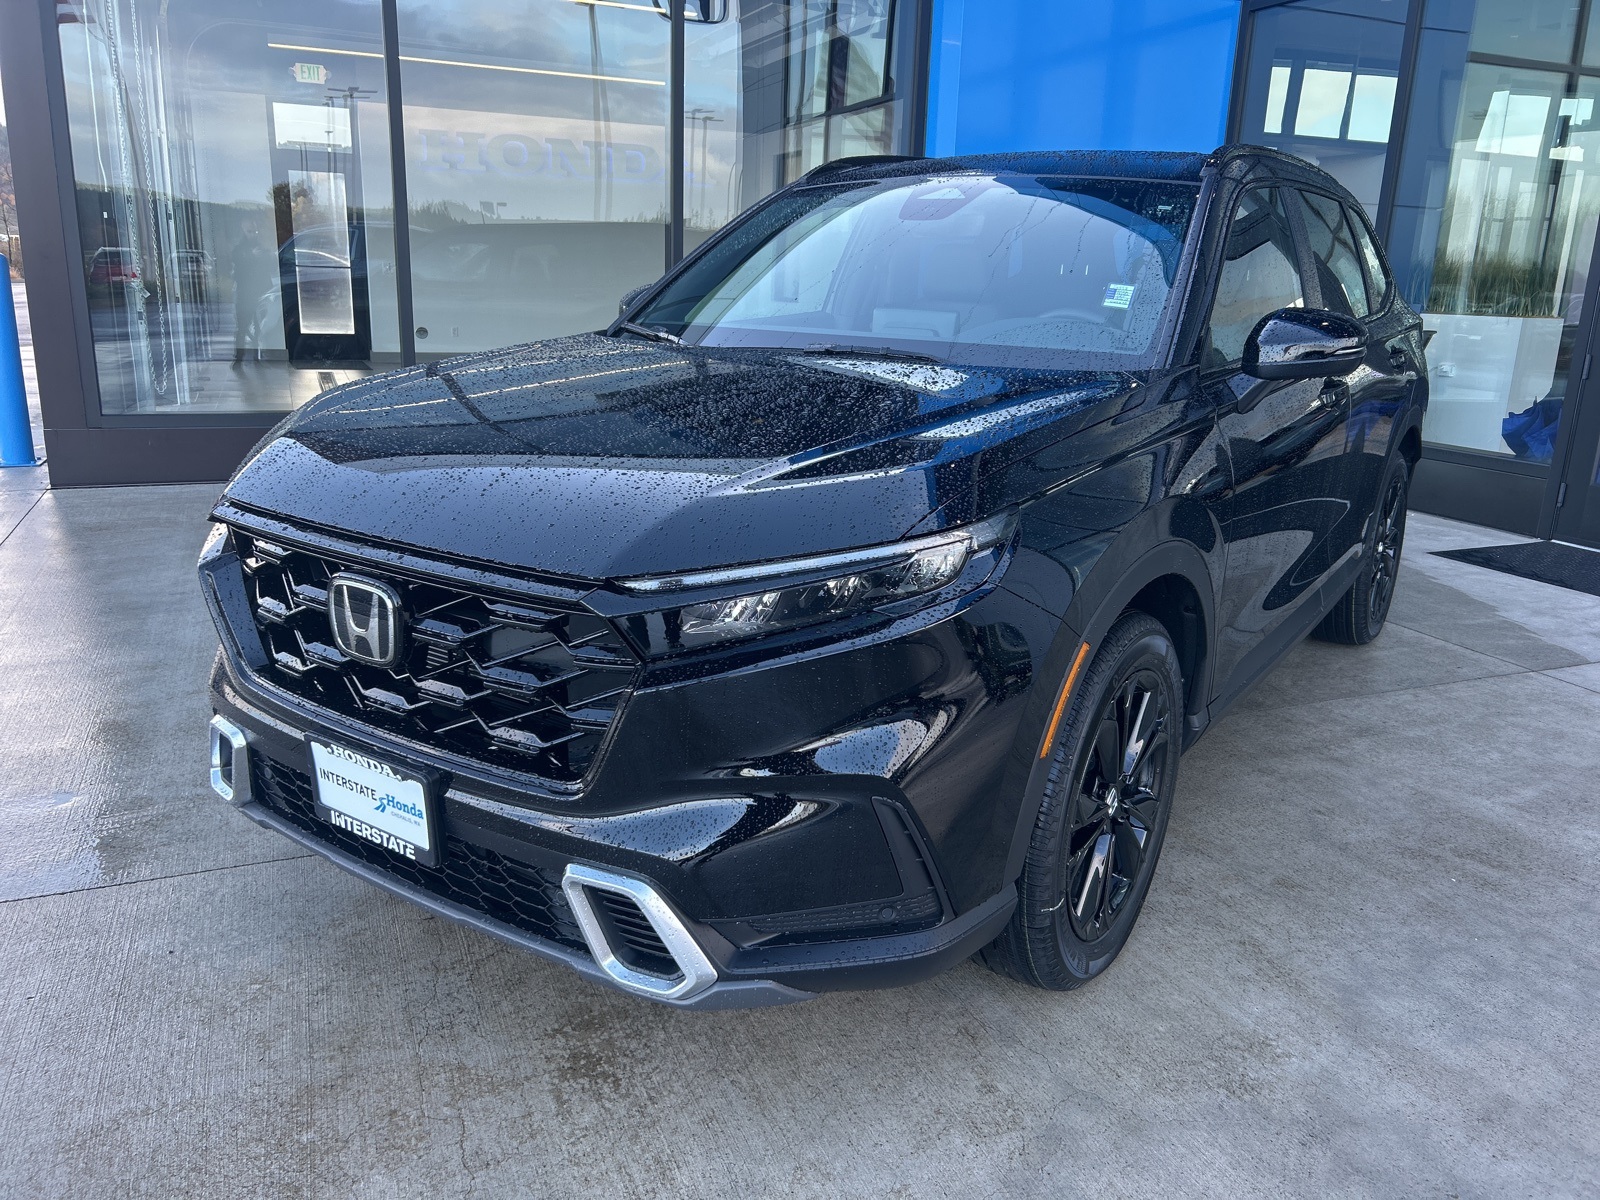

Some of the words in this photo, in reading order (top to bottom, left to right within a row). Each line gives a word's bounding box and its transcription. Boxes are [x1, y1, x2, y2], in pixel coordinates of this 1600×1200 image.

[300, 64, 321, 81] EXIT
[330, 744, 398, 779] HONDA
[319, 767, 378, 802] INTERSTATE
[385, 793, 424, 820] Honda
[330, 810, 416, 860] INTERSTATE
